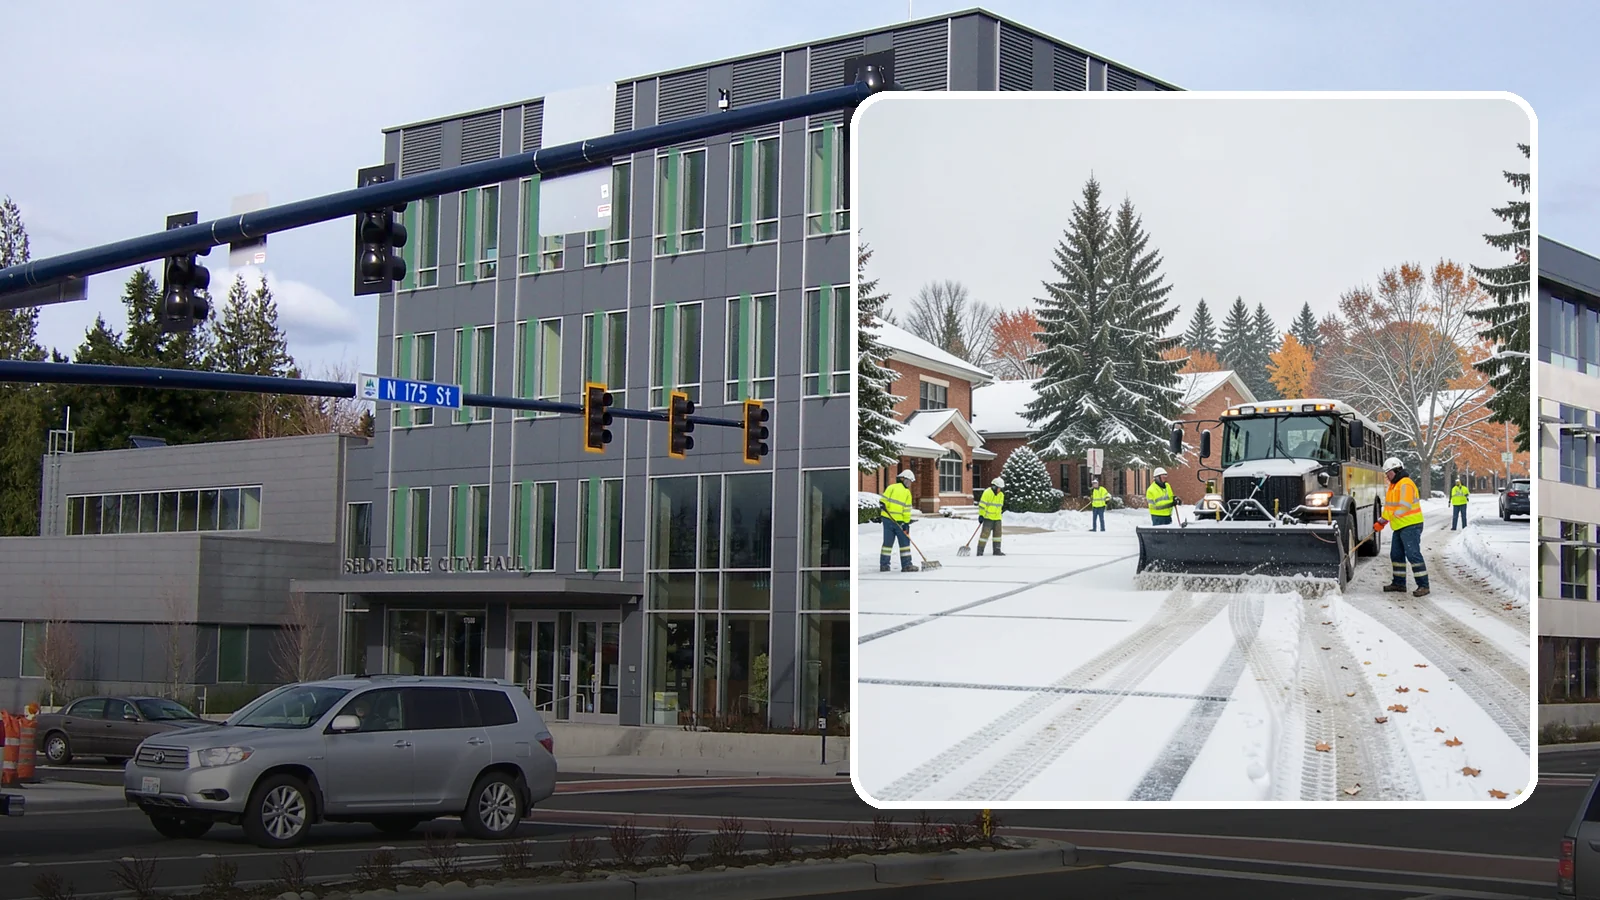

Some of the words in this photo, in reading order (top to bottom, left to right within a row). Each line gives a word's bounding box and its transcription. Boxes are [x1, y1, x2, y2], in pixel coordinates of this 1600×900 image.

[387, 380, 396, 400] N
[405, 382, 427, 403] 175
[436, 386, 452, 406] St
[344, 557, 431, 574] SHORELINE
[439, 556, 475, 573] CITY
[484, 555, 525, 572] HALL
